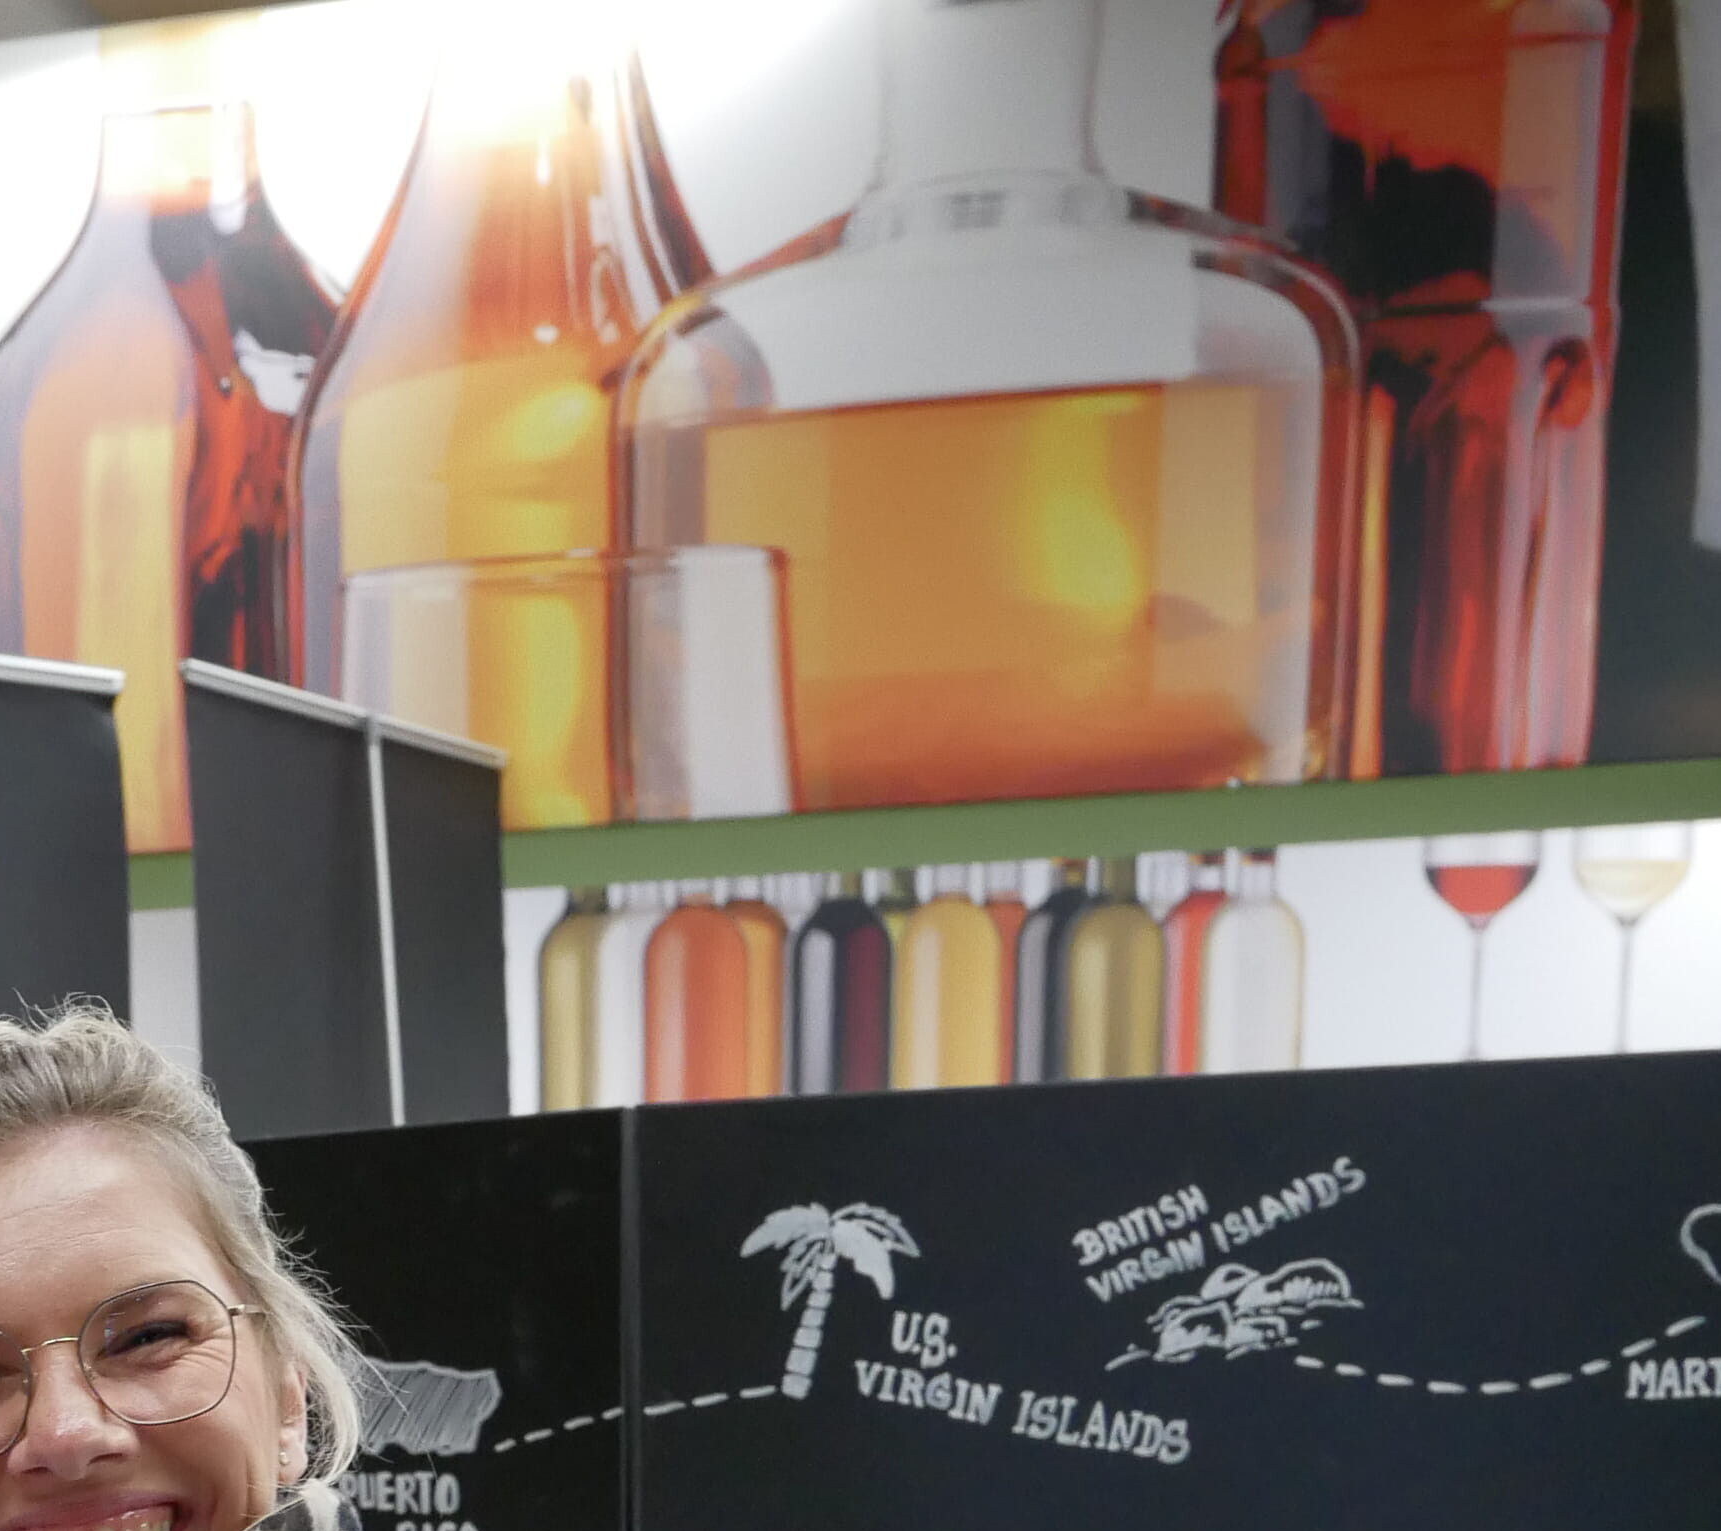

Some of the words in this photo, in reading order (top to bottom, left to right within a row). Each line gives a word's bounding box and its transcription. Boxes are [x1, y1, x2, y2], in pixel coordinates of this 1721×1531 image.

[1072, 1184, 1209, 1266] BRITISH
[1086, 1231, 1205, 1302] VIRGIN
[1210, 1156, 1366, 1253] ISLANDS
[891, 1310, 958, 1369] U.S.
[854, 1359, 1003, 1426] VIRGIN
[1011, 1390, 1191, 1464] ISLANDS
[1625, 1357, 1721, 1400] MART
[338, 1471, 461, 1515] PUERTO
